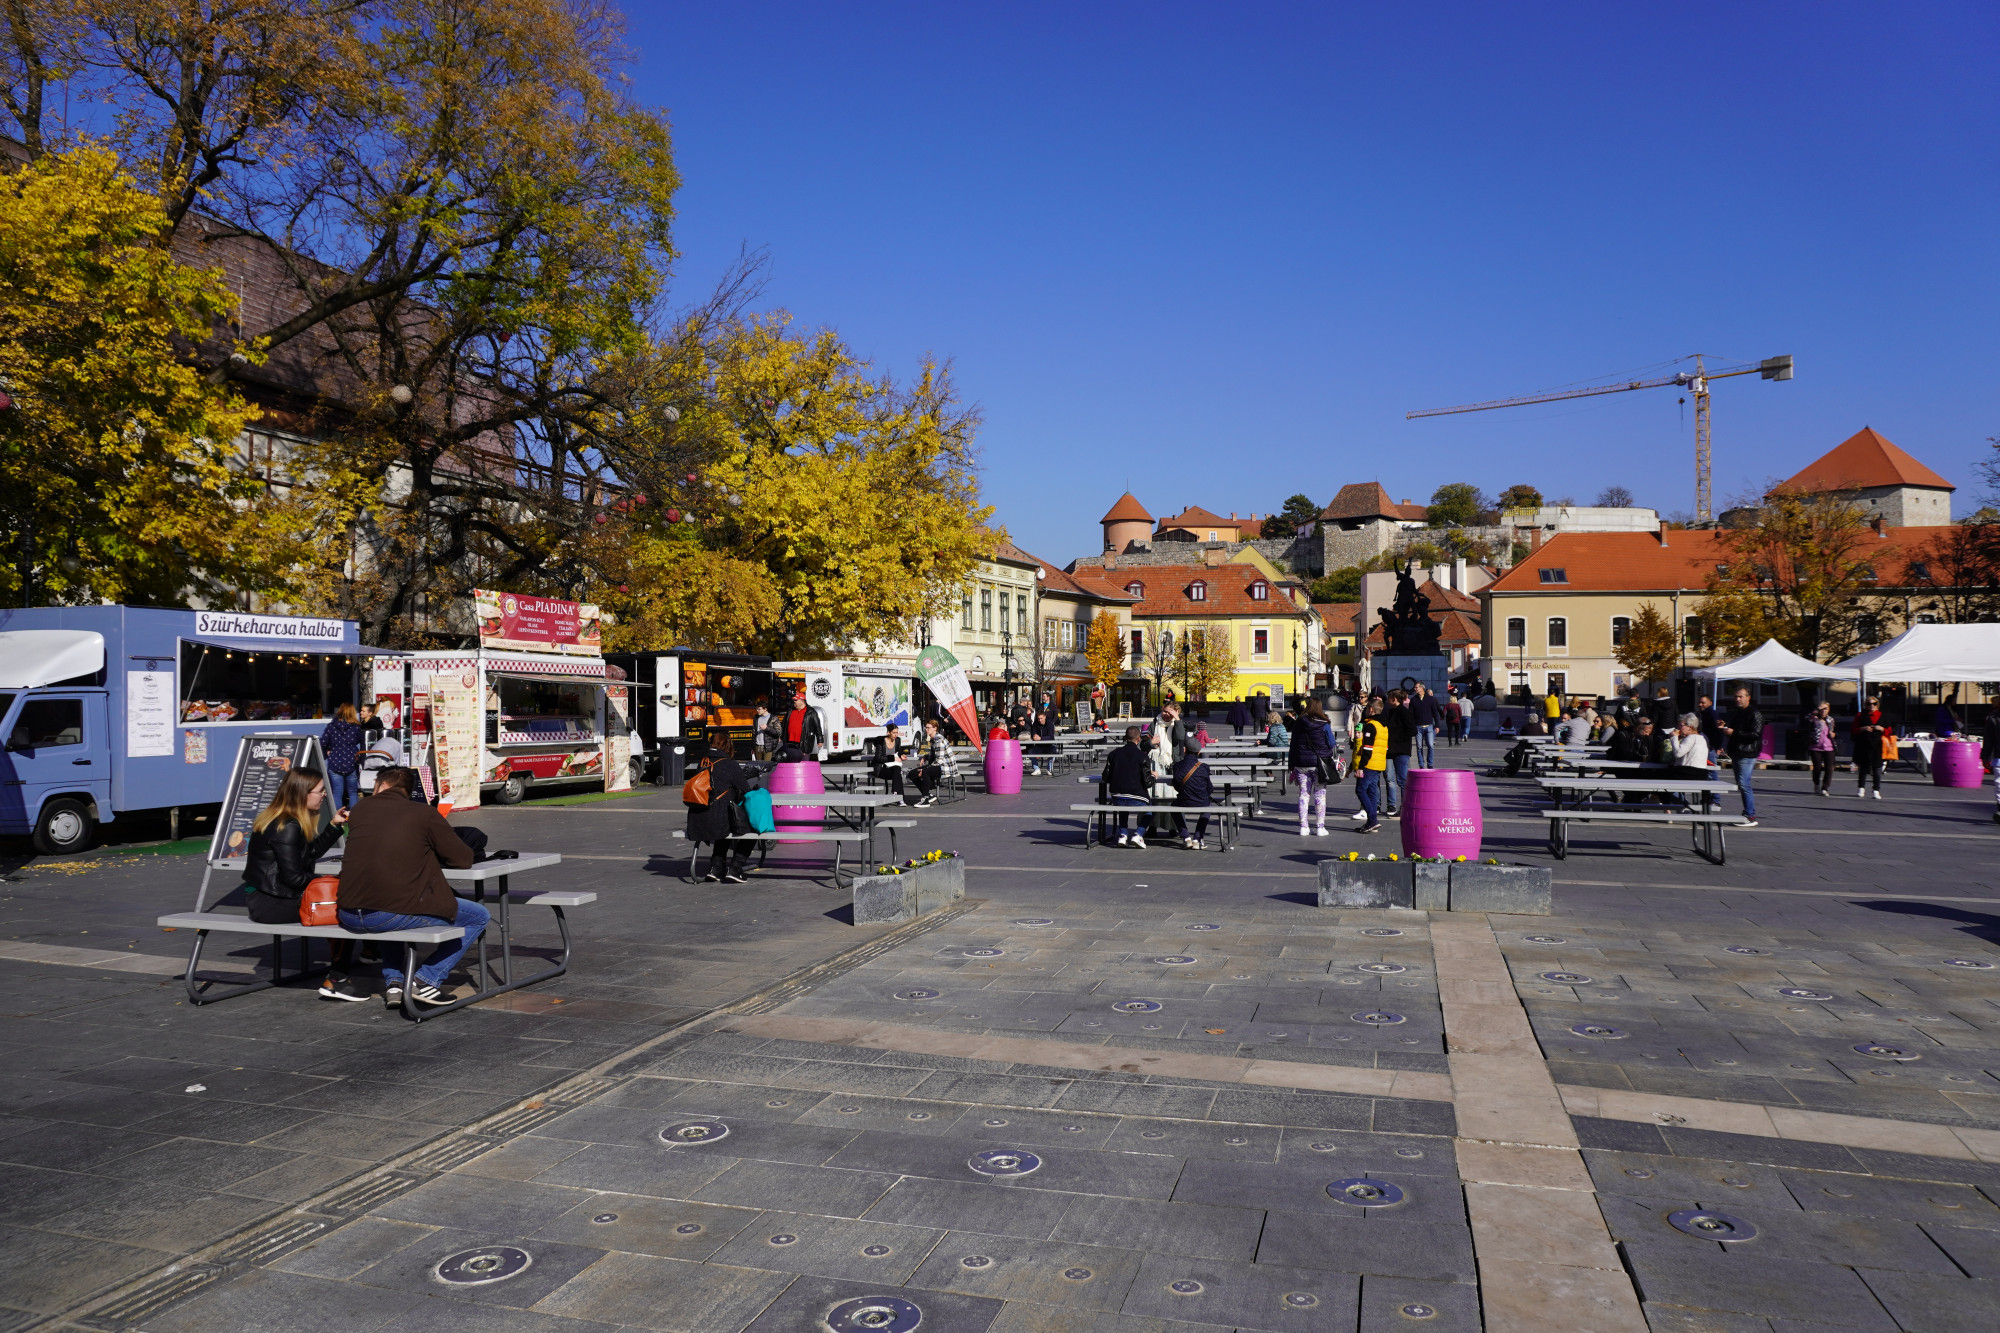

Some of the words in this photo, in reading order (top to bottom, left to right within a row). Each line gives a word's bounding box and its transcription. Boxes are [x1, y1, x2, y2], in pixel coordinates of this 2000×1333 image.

[519, 600, 534, 612] Casa
[535, 600, 574, 616] PIADINA
[199, 613, 297, 635] Szürkeharcsa
[299, 620, 342, 638] halbár
[413, 684, 429, 692] PIADI
[1441, 818, 1473, 826] CSILLAG
[1438, 826, 1476, 834] WEEKEND
